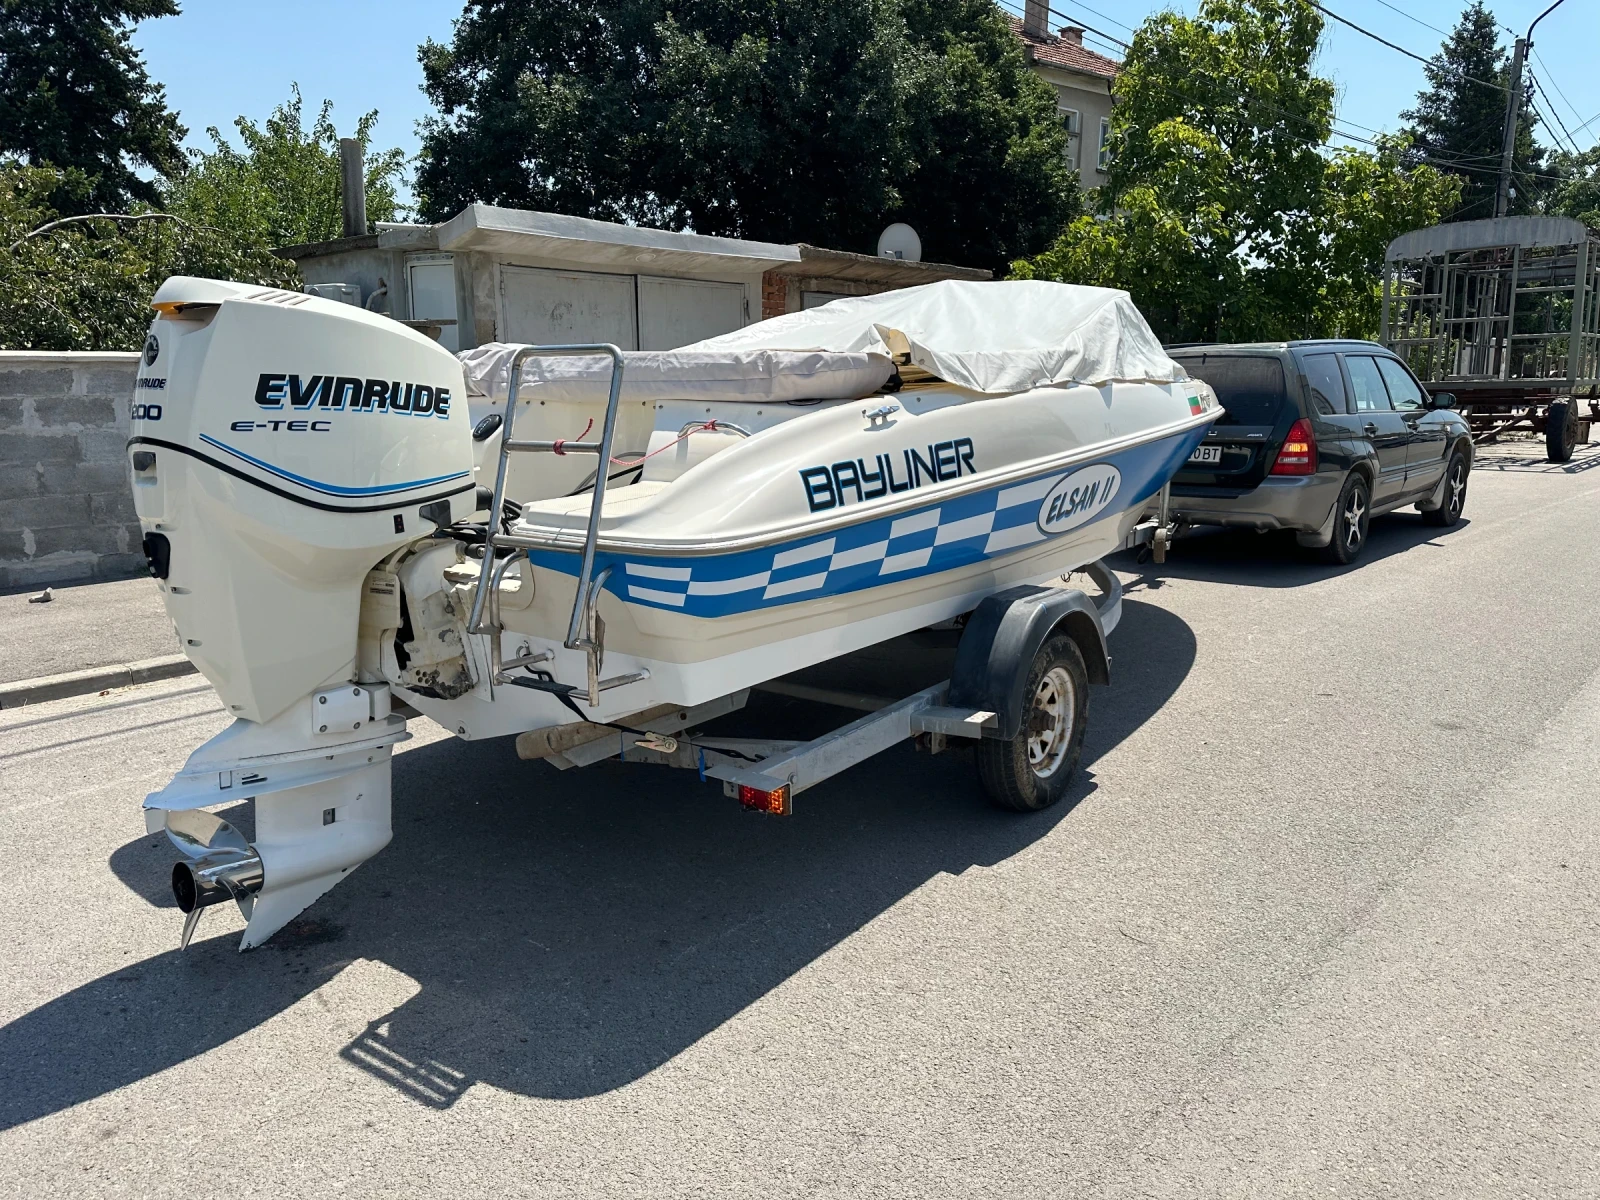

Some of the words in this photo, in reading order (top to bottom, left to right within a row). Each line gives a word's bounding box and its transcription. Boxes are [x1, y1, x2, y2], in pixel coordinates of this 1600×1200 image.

[254, 373, 451, 419] EVINRUDE
[230, 420, 332, 432] E-TEC
[798, 437, 977, 513] BAYLINER
[1045, 479, 1100, 525] ELSAN
[1098, 474, 1116, 505] II
